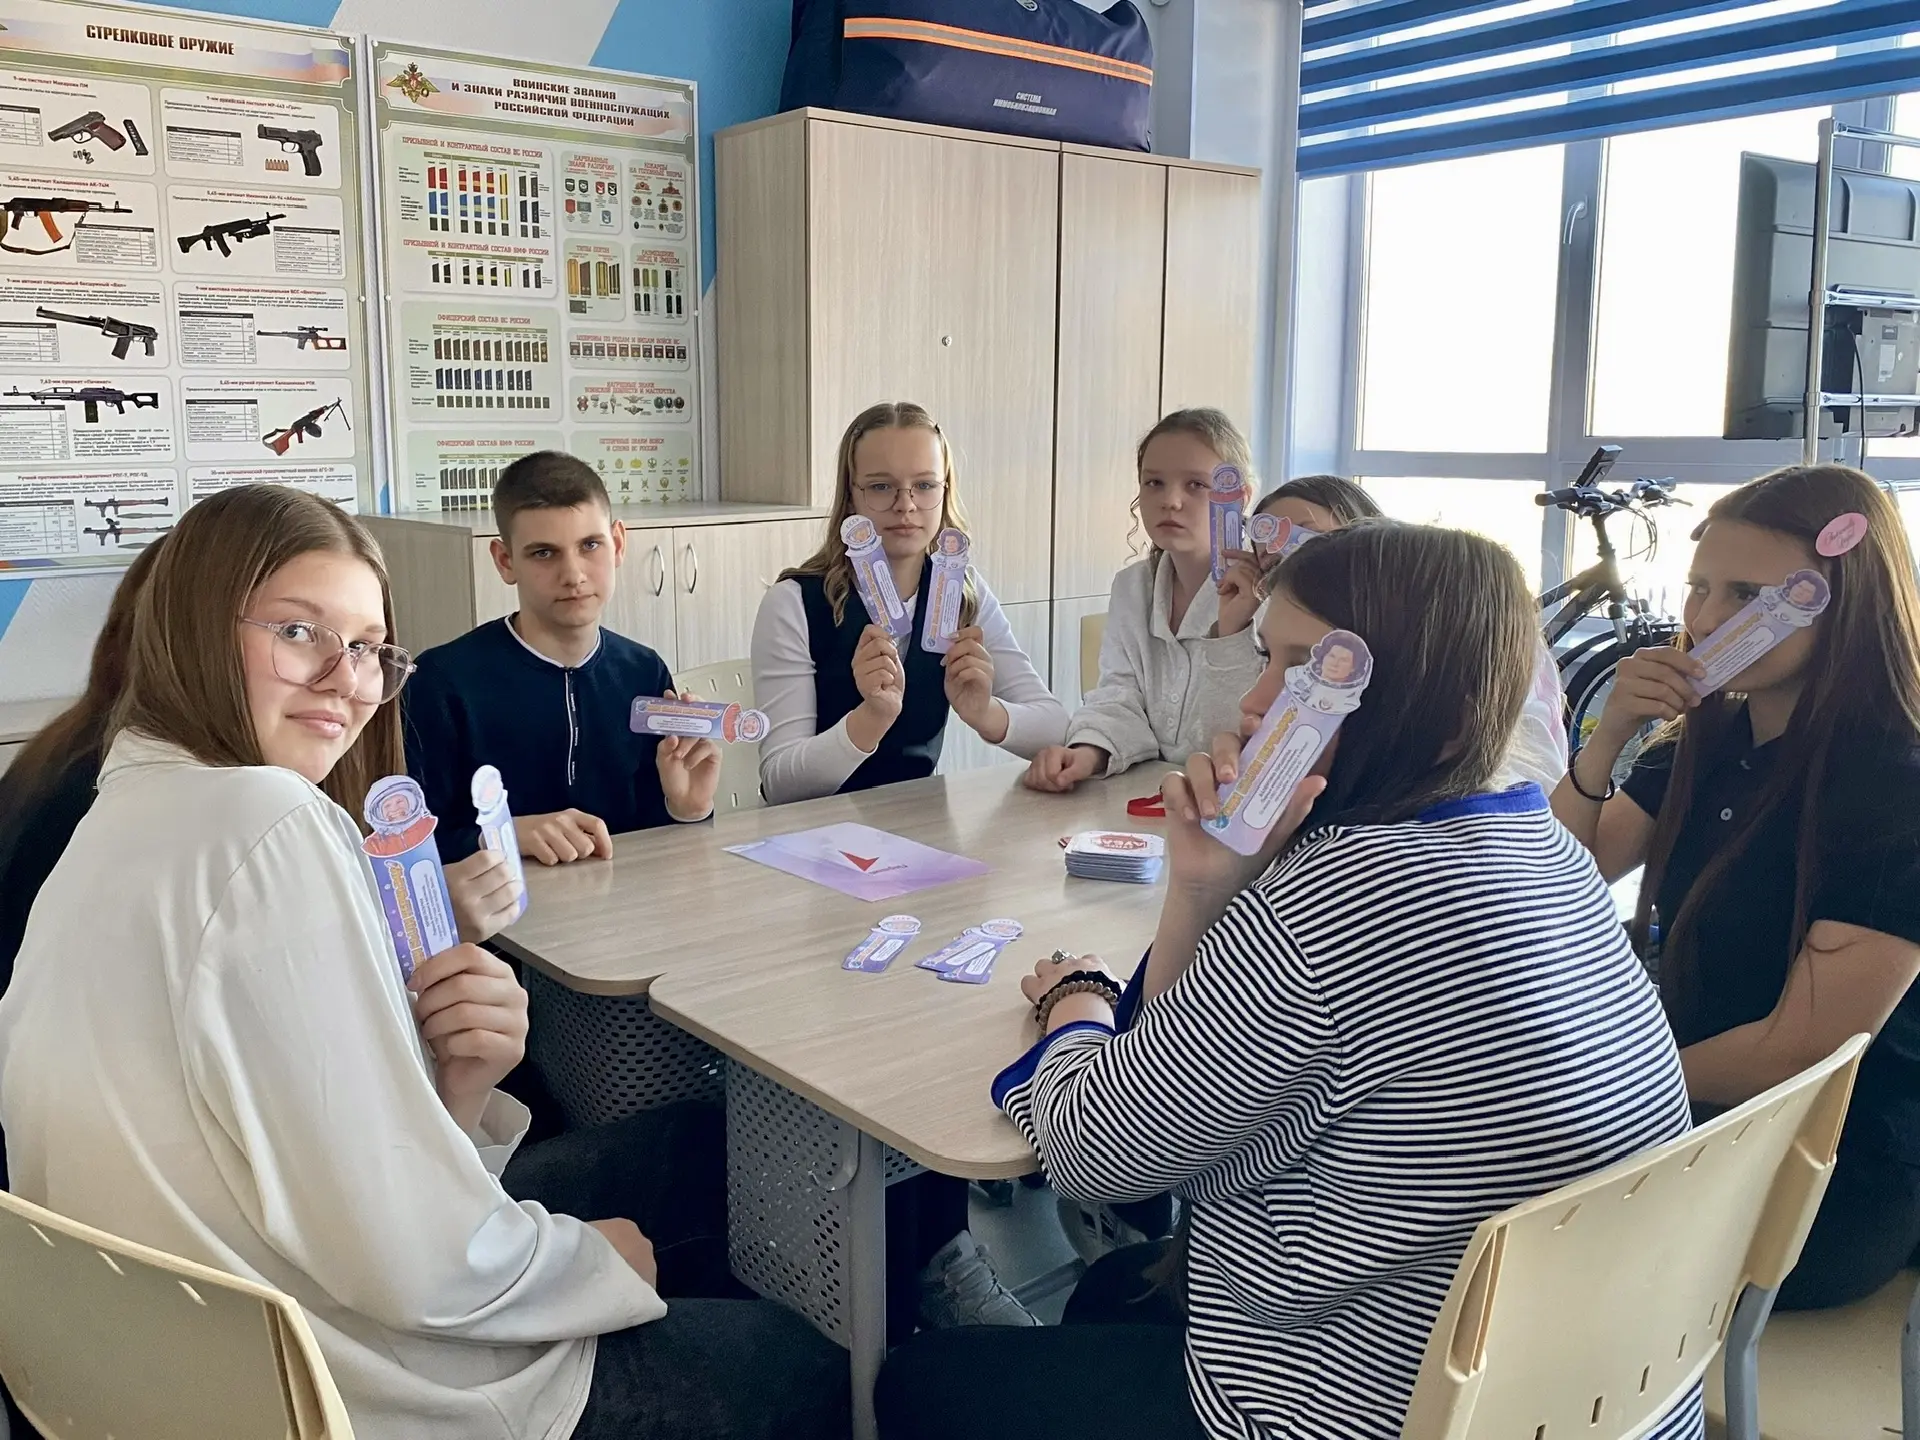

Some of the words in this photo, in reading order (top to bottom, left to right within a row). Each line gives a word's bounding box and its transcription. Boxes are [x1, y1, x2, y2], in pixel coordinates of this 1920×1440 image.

[86, 24, 174, 48] СТРЕЛКОВОЕ
[179, 36, 235, 55] ОРУЖИЕ
[513, 78, 570, 94] ВОИНСКИЕ
[573, 86, 616, 100] ЗВАНИЯ
[1016, 92, 1042, 103] СИСТЕМА
[451, 82, 460, 91] И
[464, 84, 503, 97] ЗНАКИ
[506, 90, 566, 106] РАЗЛИЧИЯ
[570, 98, 670, 119] ВОЕННОСЛУЖАЩИХ
[494, 101, 569, 118] РОССИЙСКОЙ
[572, 111, 634, 127] ФЕДЕРАЦИИ
[447, 141, 488, 152] КОНТРАКТНЫЙ
[490, 146, 511, 154] СОСТАВ
[522, 150, 543, 158] РОССИИ
[448, 242, 489, 251] КОНТРАКТНЫЙ
[438, 314, 476, 322] ОФИЦЕРСКИЙ
